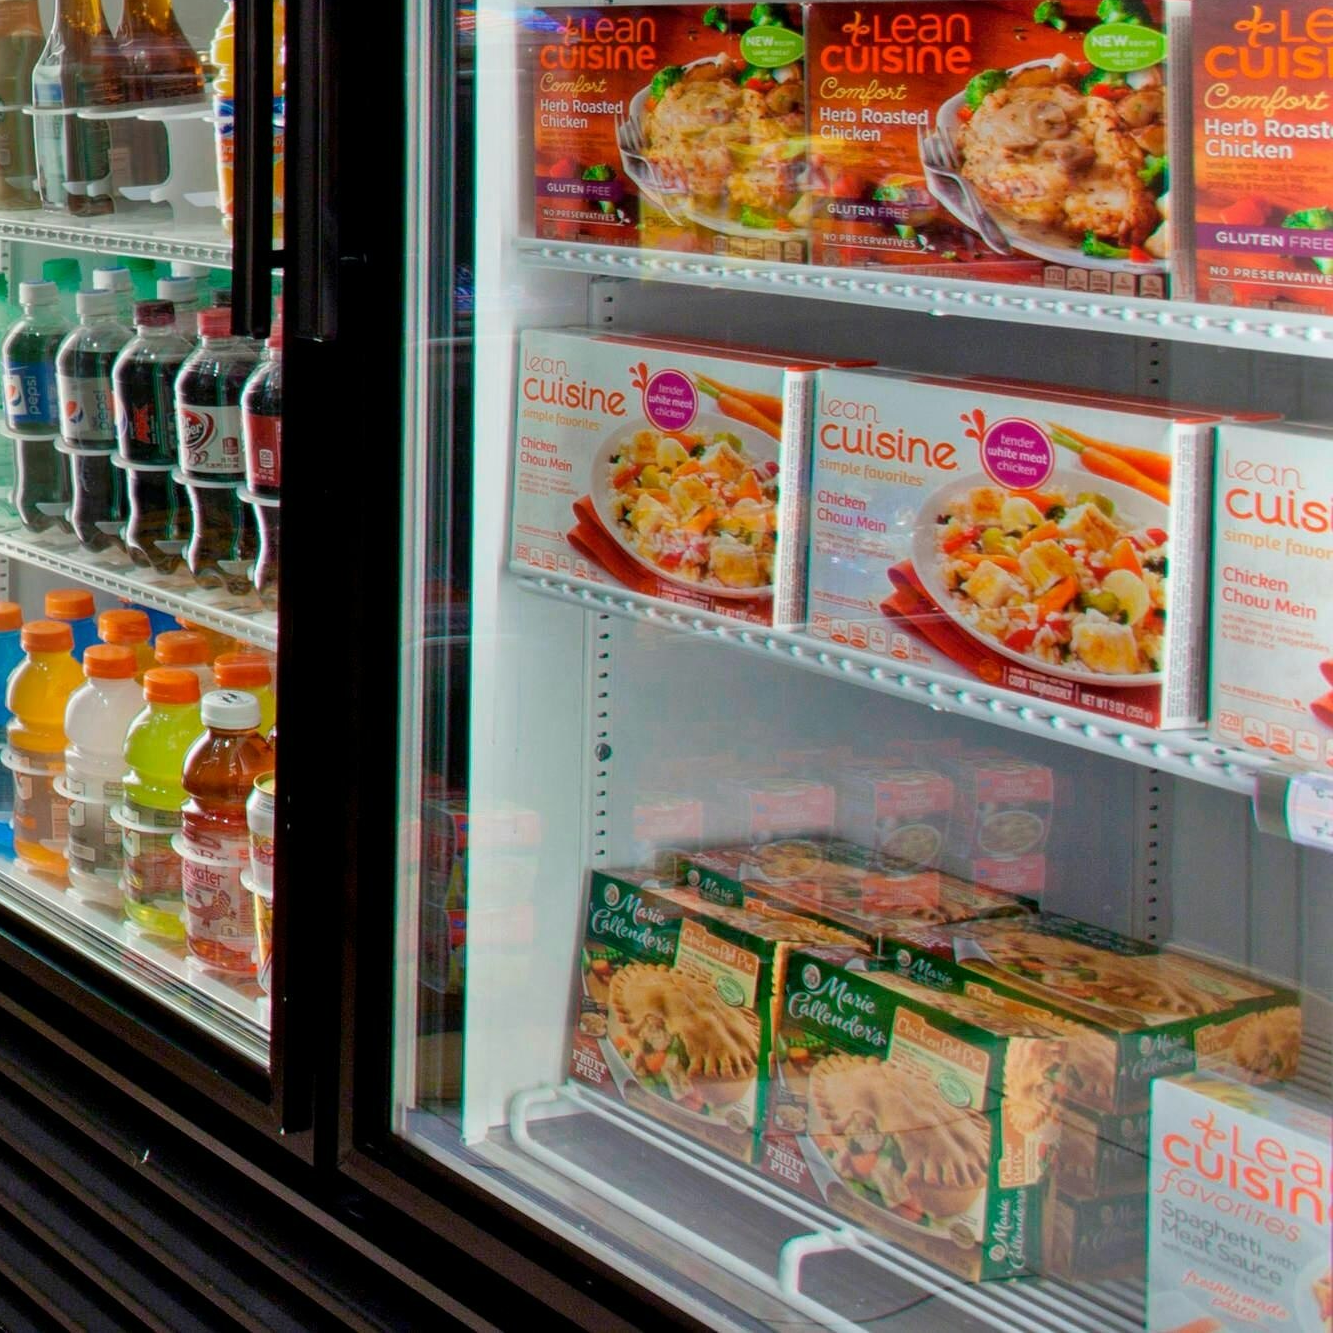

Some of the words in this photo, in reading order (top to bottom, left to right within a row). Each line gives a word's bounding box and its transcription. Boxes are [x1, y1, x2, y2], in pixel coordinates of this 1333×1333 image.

[580, 15, 656, 43] Lean
[874, 12, 972, 42] Lean
[745, 36, 773, 47] NEW
[1092, 35, 1130, 48] NEW
[540, 72, 607, 95] Comfort
[820, 77, 906, 101] Comfort
[541, 99, 568, 113] Herb
[573, 100, 623, 114] Roasted
[1204, 83, 1328, 118] Comfort
[541, 115, 588, 129] Chicken
[820, 107, 857, 122] Herb
[861, 108, 928, 125] Roasted
[1204, 118, 1257, 137] Herb
[820, 125, 881, 142] Chicken
[1205, 139, 1293, 159] Chicken
[547, 183, 584, 194] GLUTEN
[586, 185, 611, 196] FREE
[560, 209, 615, 222] PRESERVATIVES
[827, 203, 874, 217] GLUTEN
[878, 205, 910, 219] FREE
[840, 234, 915, 248] PRESERVATIVES
[1216, 230, 1284, 247] GLUTEN
[1289, 235, 1333, 250] FREE
[1210, 265, 1229, 277] NO
[24, 376, 41, 414] pepsi
[522, 377, 627, 417] cuisine
[820, 390, 880, 424] lean
[520, 436, 557, 454] Chicken
[819, 423, 958, 471] cuisine
[999, 432, 1036, 450] tender
[520, 452, 548, 468] Chow
[550, 458, 573, 472] Mein
[987, 445, 1016, 462] white
[1019, 449, 1049, 466] meat
[818, 456, 861, 478] simple
[863, 462, 924, 488] favorites
[1224, 448, 1304, 491] lean
[817, 490, 867, 511] Chicken
[817, 507, 852, 526] Chow
[856, 516, 886, 533] Mein
[1224, 529, 1282, 552] simple
[1223, 567, 1289, 593] Chicken
[1222, 586, 1269, 611] Chow
[1275, 600, 1316, 620] Mein
[606, 893, 667, 927] Marie
[590, 902, 674, 954] Callender's
[804, 976, 876, 1014] Marie
[786, 985, 887, 1047] Callender's
[573, 1049, 606, 1074] FRUIT
[575, 1063, 602, 1083] PIES
[766, 1146, 807, 1173] FRUIT
[770, 1161, 800, 1184] PIES
[1155, 1168, 1300, 1243] favorites
[1161, 1199, 1261, 1257] Spaghetti
[1161, 1218, 1212, 1255] Meat
[1218, 1244, 1283, 1285] Sauce
